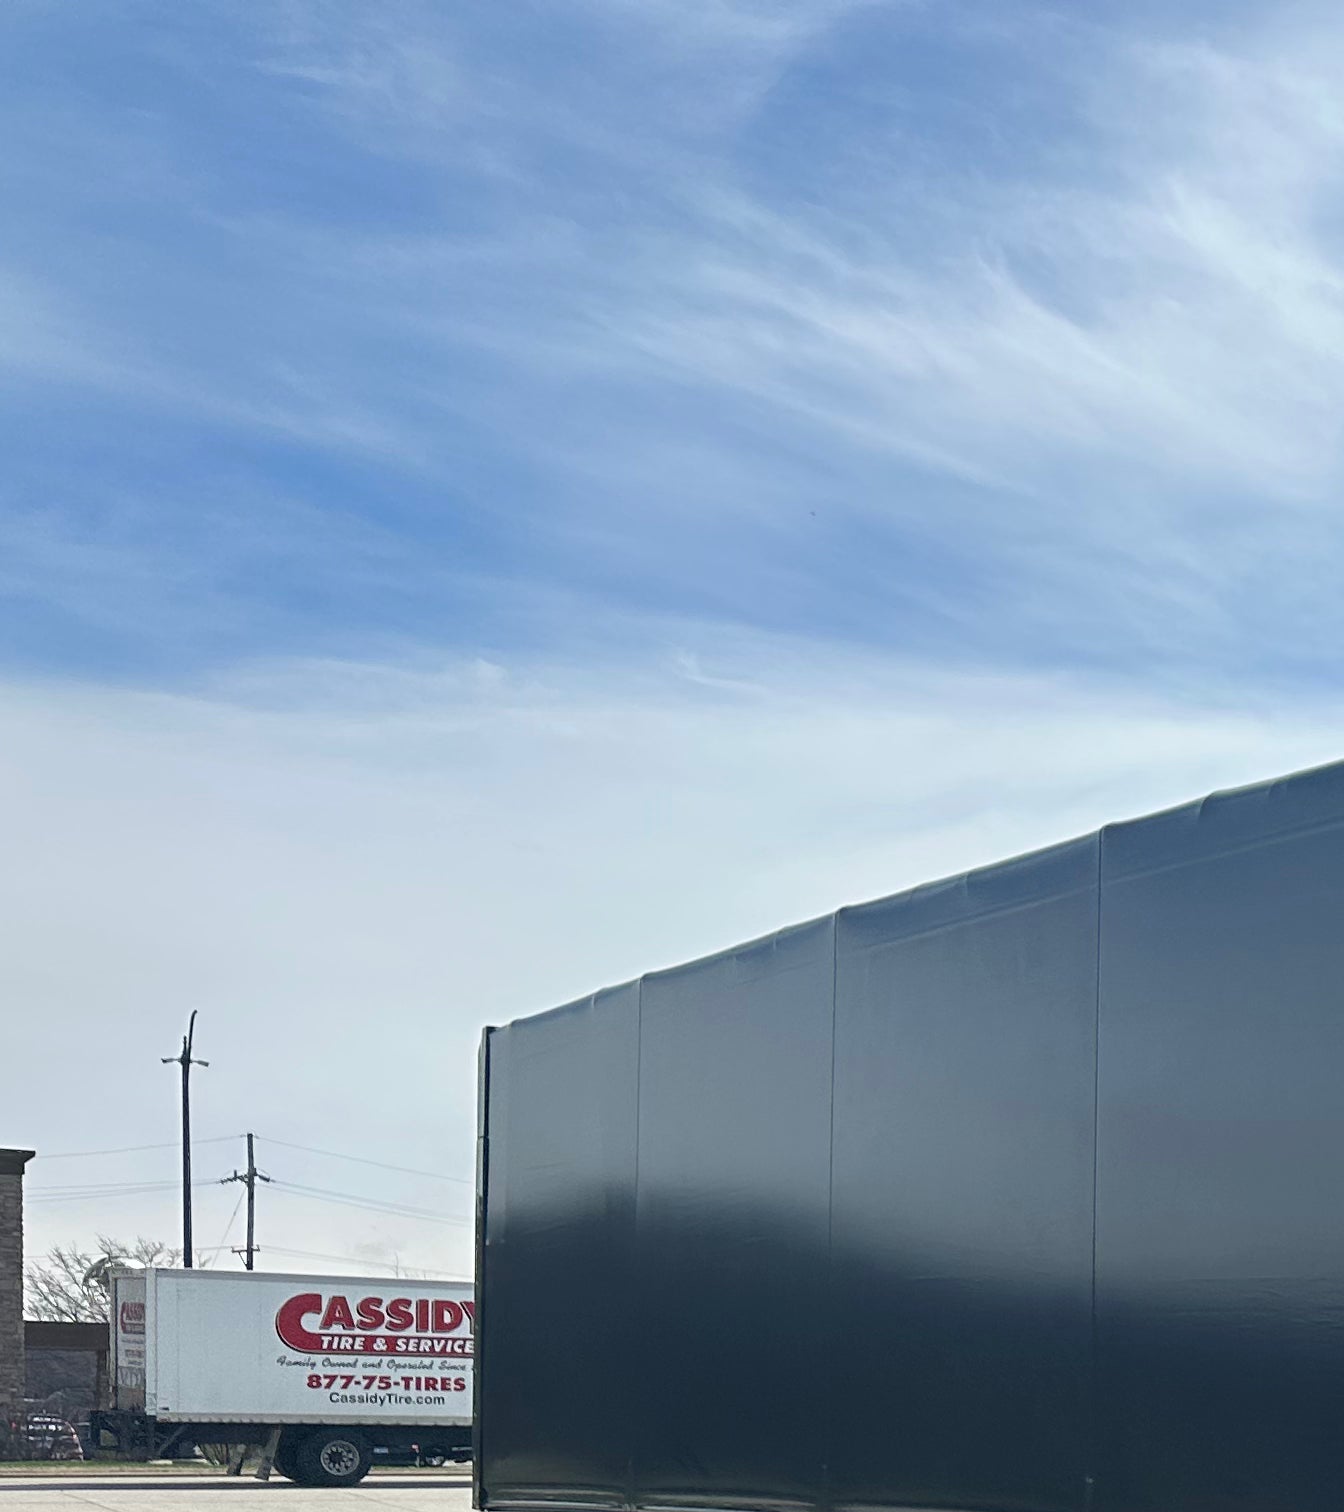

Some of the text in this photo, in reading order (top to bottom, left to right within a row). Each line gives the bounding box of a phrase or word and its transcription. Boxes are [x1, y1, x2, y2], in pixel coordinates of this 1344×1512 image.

[321, 1336, 475, 1353] TIRE & SERVICE
[276, 1355, 317, 1370] Family
[321, 1357, 359, 1369] Owned
[362, 1358, 383, 1369] and
[386, 1359, 434, 1372] Operated
[438, 1360, 467, 1371] Since
[307, 1374, 466, 1391] 877-75-TIRES
[329, 1392, 445, 1406] CassidyTire.com
